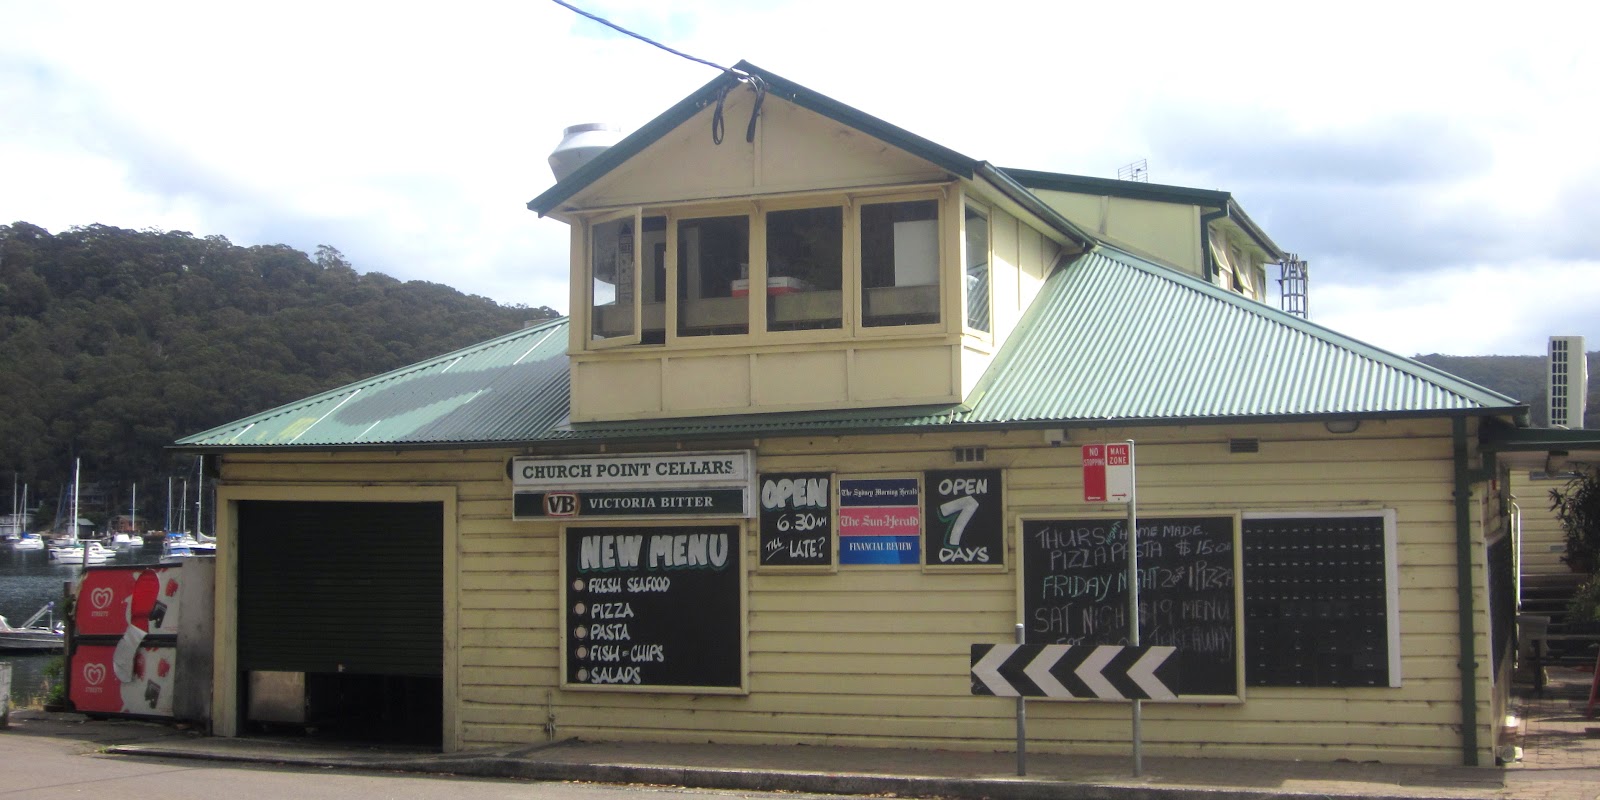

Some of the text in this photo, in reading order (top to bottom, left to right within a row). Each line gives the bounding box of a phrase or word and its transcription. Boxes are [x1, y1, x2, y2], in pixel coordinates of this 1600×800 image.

[1089, 447, 1099, 457] NO
[1110, 447, 1126, 455] MAIL
[1083, 458, 1105, 467] STOPPING
[1109, 456, 1127, 465] ZONE
[522, 460, 734, 480] CHURCH POINT CELLARS
[761, 478, 829, 509] OPEN
[841, 487, 918, 498] The Sydney Morning Herald
[938, 478, 988, 496] OPEN
[548, 495, 576, 514] VB
[589, 496, 714, 509] VICTORIA BITTER
[840, 514, 919, 529] The Sun-Herald
[939, 495, 980, 547] 7
[1035, 527, 1106, 549] THURS
[1119, 526, 1158, 541] HME
[578, 533, 730, 573] NEW MENU
[765, 537, 783, 552] TILL
[849, 542, 913, 551] FINANCIAL REVIEW
[938, 546, 990, 562] DAYS
[1050, 546, 1107, 571] PIZZA
[588, 576, 671, 593] FRESH SEAFOOD
[1042, 573, 1113, 603] FRIDAY
[591, 602, 635, 620] PIZZA
[1034, 602, 1130, 635] SAT NIGH
[1182, 598, 1231, 621] MENU
[590, 623, 631, 641] PASTA
[590, 645, 620, 662] FISH
[630, 644, 665, 663] CHIPS
[591, 666, 641, 684] SALADS
